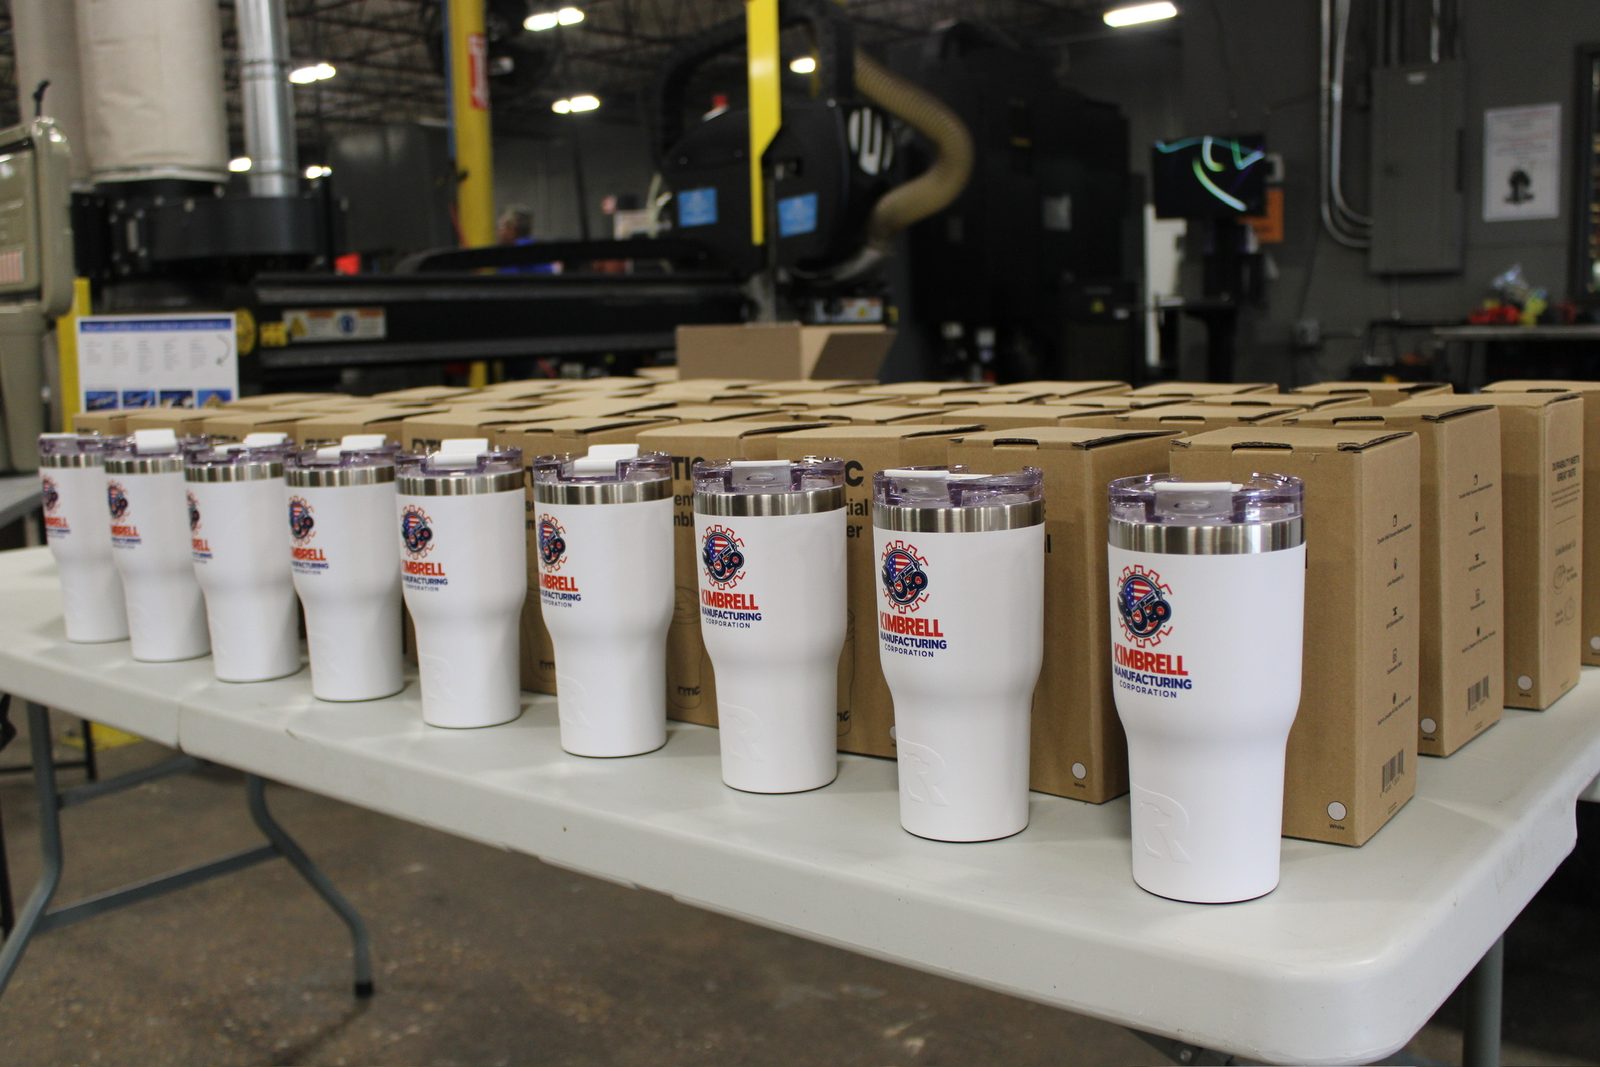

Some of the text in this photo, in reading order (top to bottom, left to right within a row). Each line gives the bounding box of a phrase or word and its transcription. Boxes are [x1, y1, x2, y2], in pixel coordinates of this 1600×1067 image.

[701, 588, 759, 610] KIMBRELL
[701, 606, 762, 622] MANUFACTURING
[705, 617, 750, 629] CORPORATION
[880, 610, 944, 637] KIMBRELL
[880, 630, 947, 650] MANUFACTURING
[884, 643, 934, 658] CORPORATION
[1114, 642, 1188, 676] KIMBRELL
[1114, 664, 1192, 690] MANUFACTURING
[1119, 679, 1177, 698] CORPORATION
